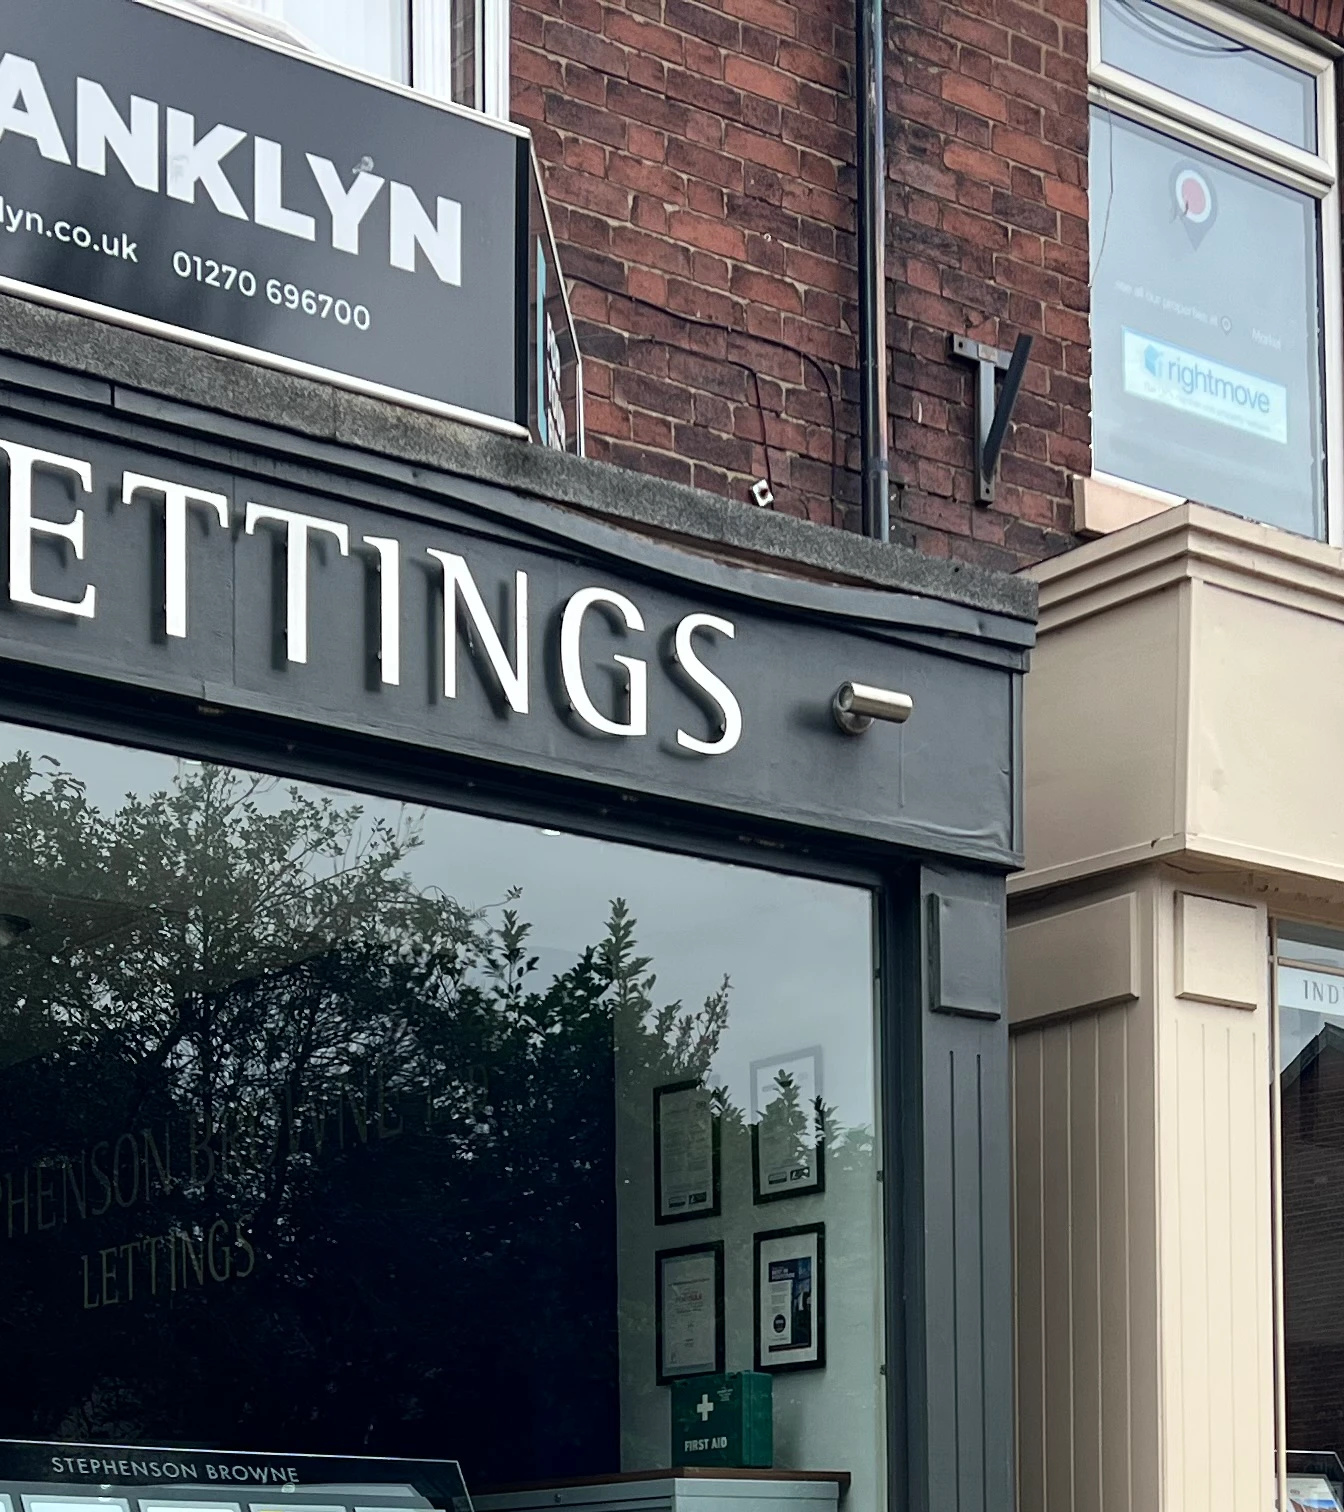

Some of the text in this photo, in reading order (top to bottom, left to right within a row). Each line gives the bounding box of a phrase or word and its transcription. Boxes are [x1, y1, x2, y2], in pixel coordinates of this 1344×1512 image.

[173, 250, 257, 297] 01270
[265, 278, 371, 331] 696700
[1168, 357, 1270, 413] rightmove
[81, 1213, 256, 1310] LETTINGS
[51, 1456, 300, 1484] STEPHENSON BROWNE
[684, 1436, 728, 1453] FIRST AID
